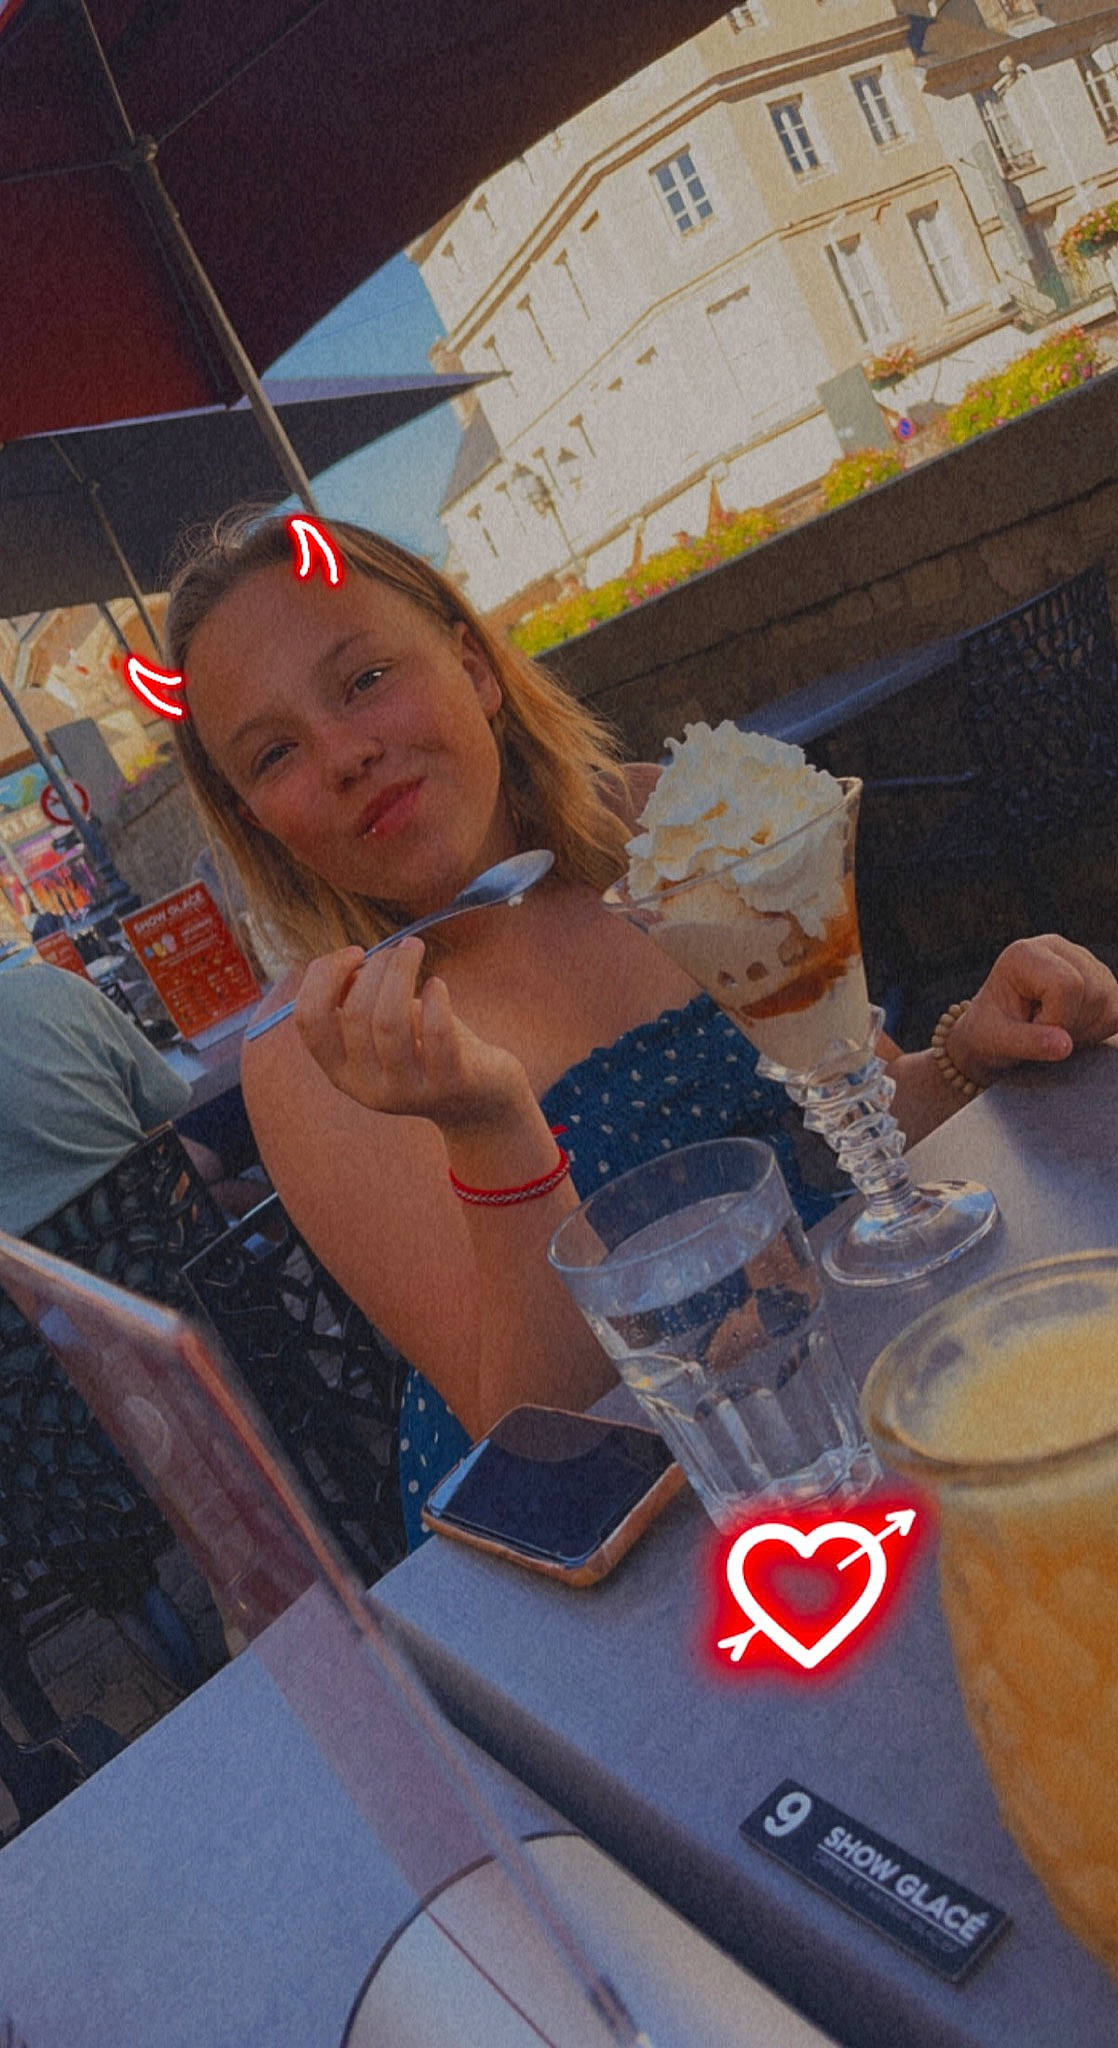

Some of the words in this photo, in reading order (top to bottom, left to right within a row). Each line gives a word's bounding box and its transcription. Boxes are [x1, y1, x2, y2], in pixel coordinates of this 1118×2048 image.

[764, 1791, 812, 1837] 9
[824, 1826, 901, 1882] SHOW
[895, 1873, 990, 1941] GLACÉ
